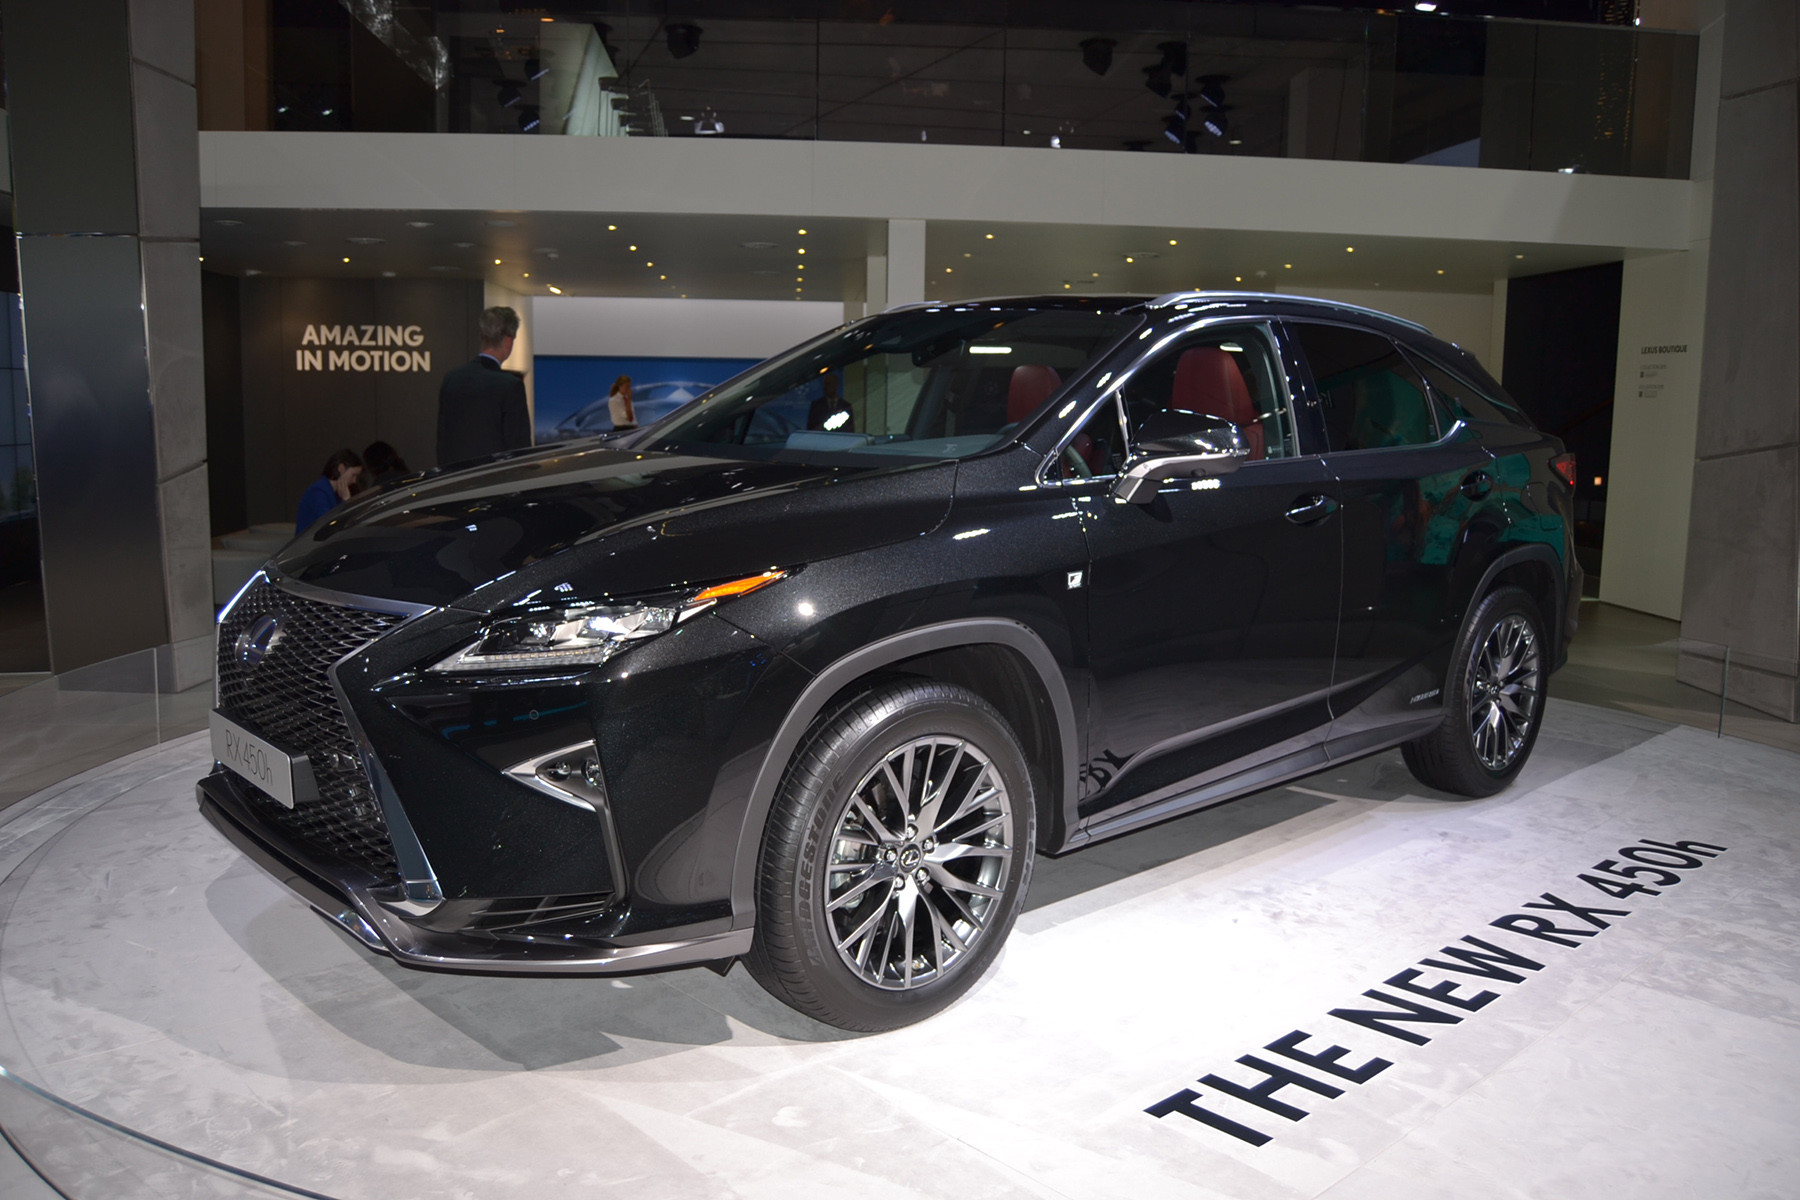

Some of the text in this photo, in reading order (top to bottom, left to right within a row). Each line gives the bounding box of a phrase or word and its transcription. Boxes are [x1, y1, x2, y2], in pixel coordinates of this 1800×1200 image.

[301, 324, 425, 347] AMAZING
[296, 349, 431, 373] IN MOTION
[225, 728, 273, 787] RX 450h
[1144, 838, 1728, 1148] THE NEW RX 450h
